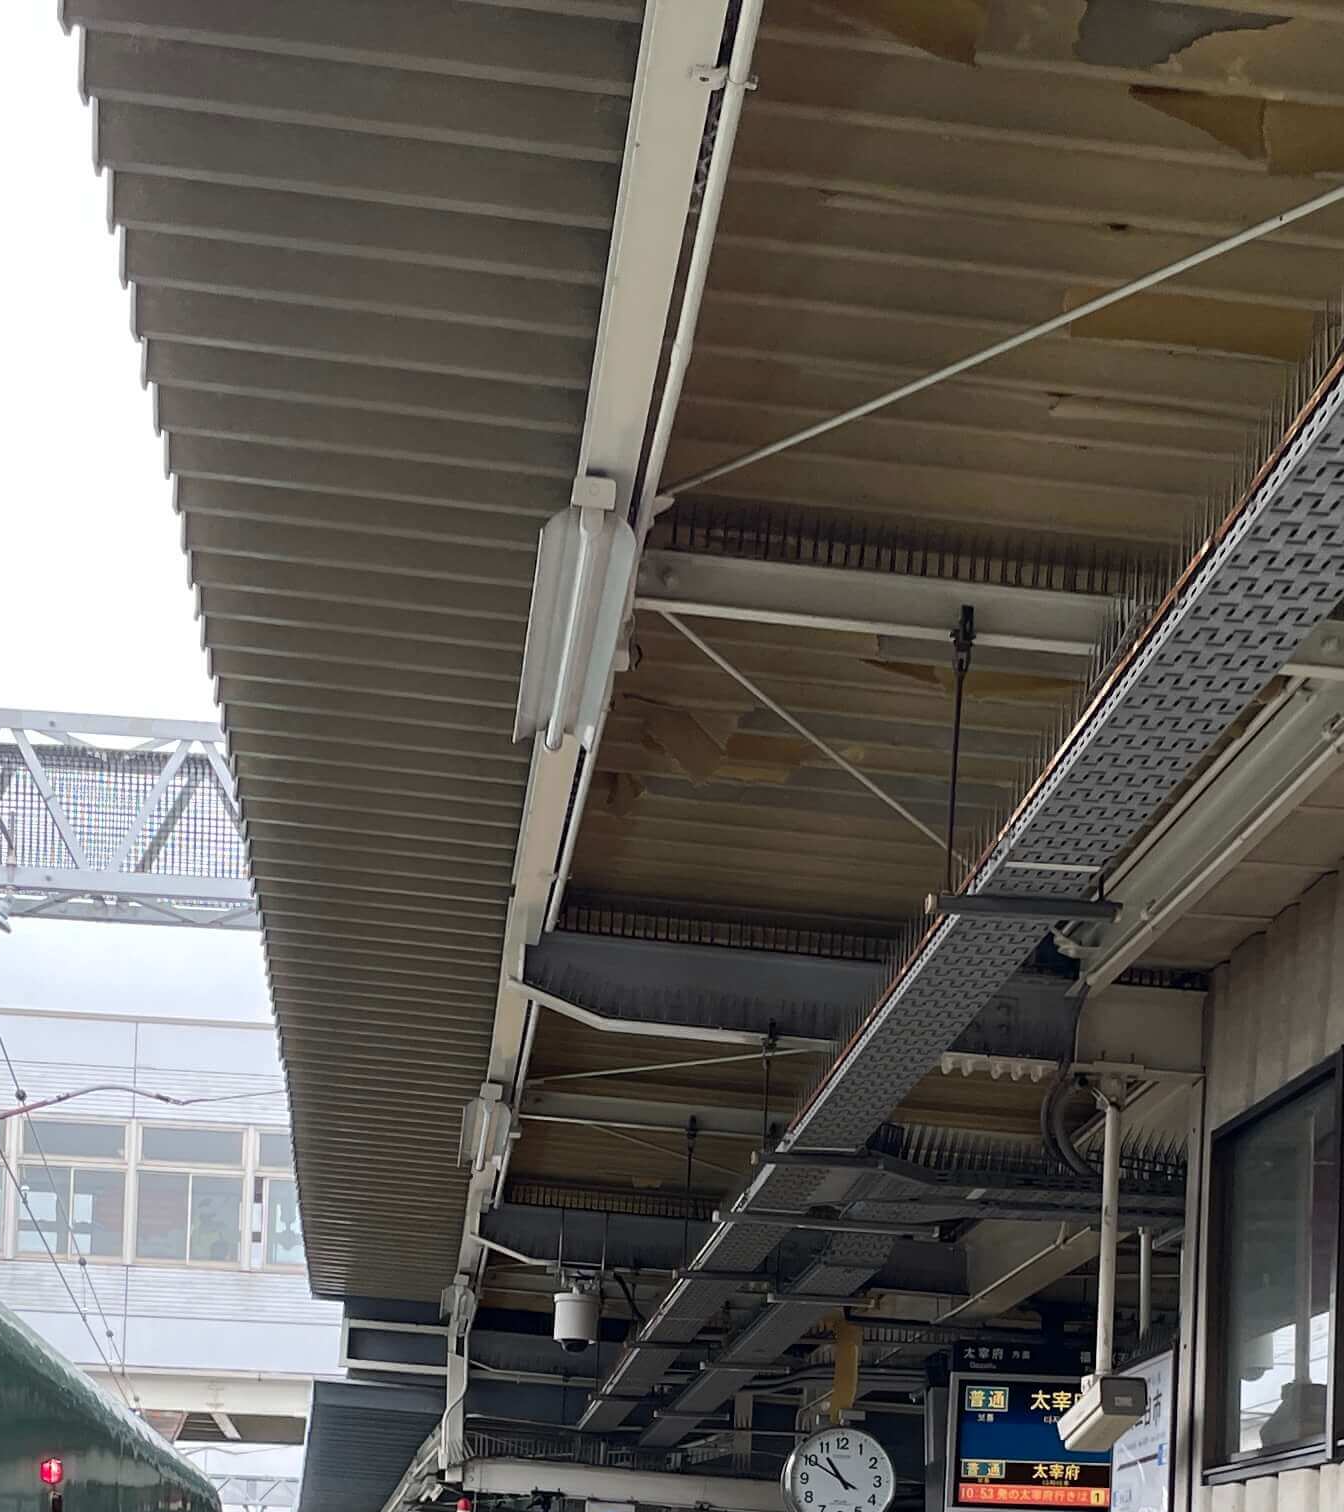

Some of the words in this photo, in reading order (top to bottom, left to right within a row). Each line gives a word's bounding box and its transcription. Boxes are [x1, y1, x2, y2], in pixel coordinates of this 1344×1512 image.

[969, 1390, 1005, 1409] 普通
[820, 1442, 830, 1454] 11
[836, 1437, 849, 1450] 12
[859, 1443, 863, 1455] 1
[804, 1454, 818, 1466] 10
[868, 1457, 878, 1469] 2
[967, 1462, 1000, 1477] 普通
[1032, 1463, 1081, 1481] 太宰府
[800, 1472, 809, 1484] 9
[873, 1475, 882, 1488] 3
[804, 1491, 814, 1503] 8
[867, 1494, 876, 1506] 4
